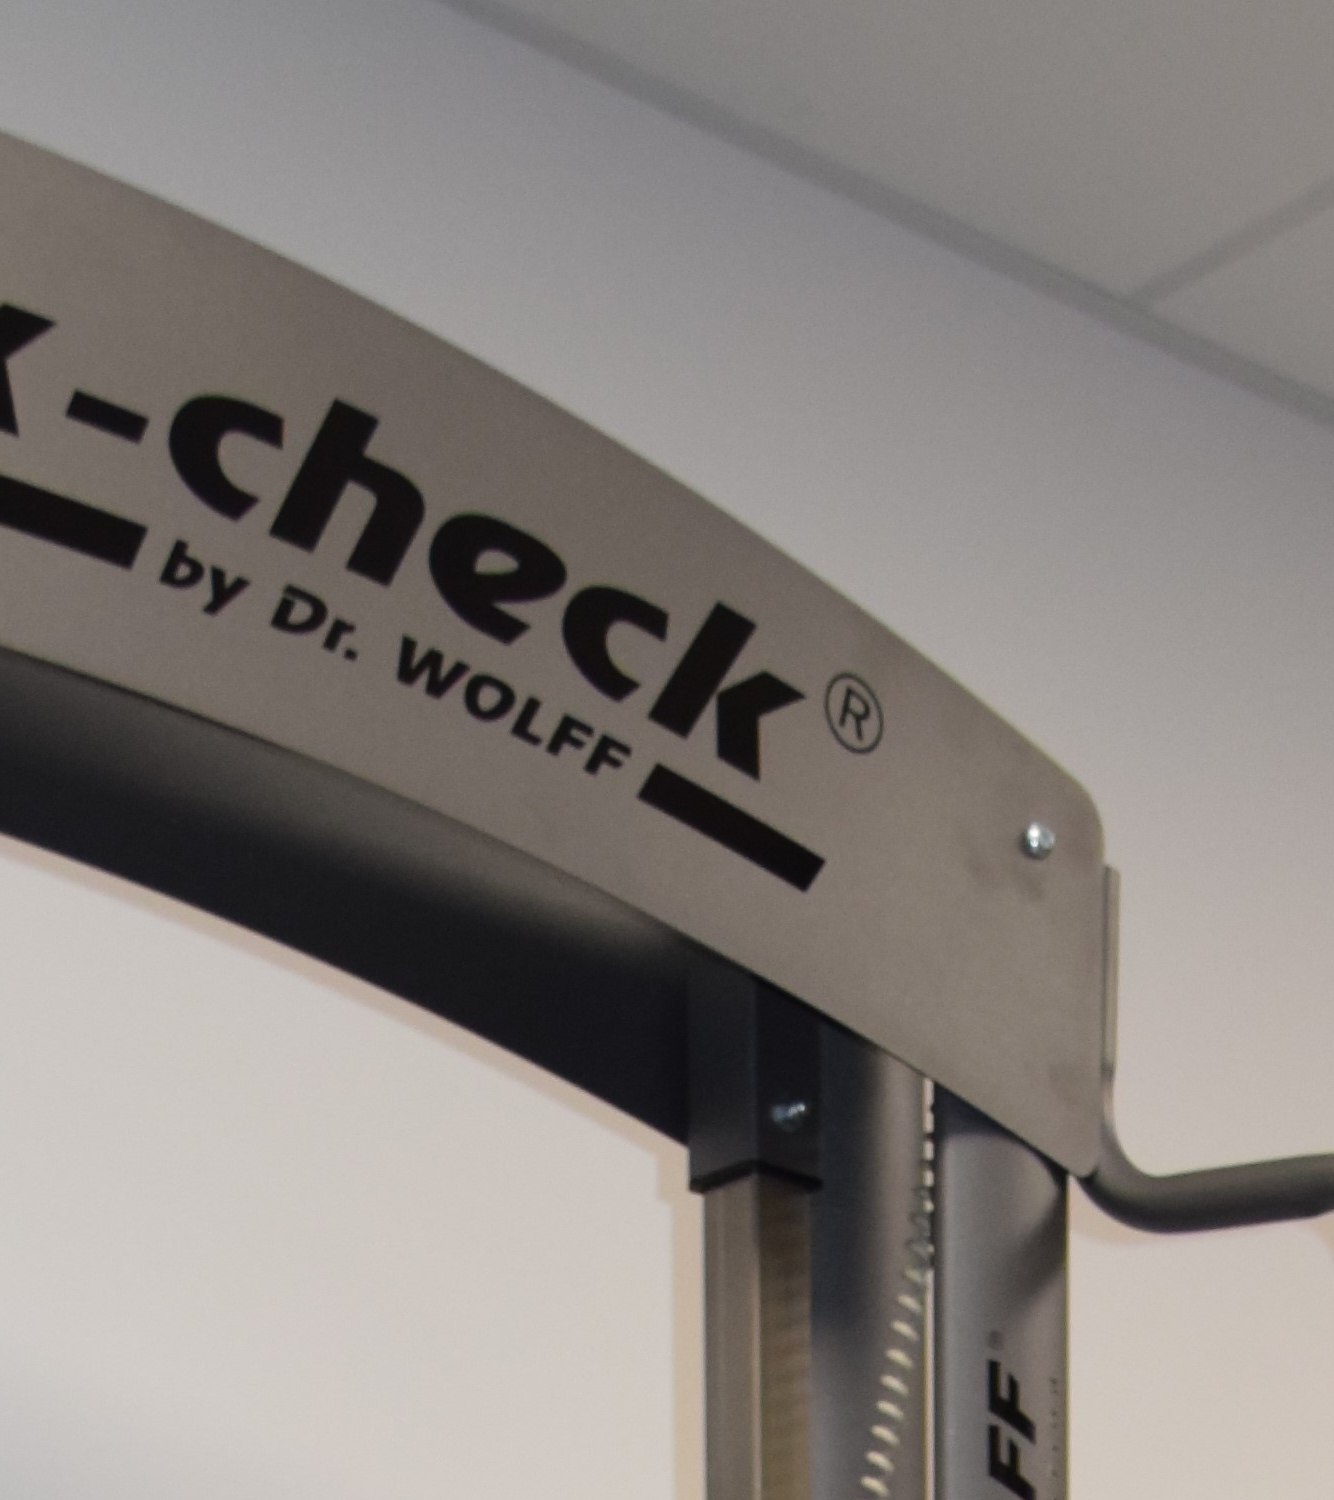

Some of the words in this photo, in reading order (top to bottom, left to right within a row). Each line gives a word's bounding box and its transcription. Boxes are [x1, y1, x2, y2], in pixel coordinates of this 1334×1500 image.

[158, 539, 249, 618] by
[268, 584, 360, 663] Dr.
[394, 636, 633, 781] WOLFF
